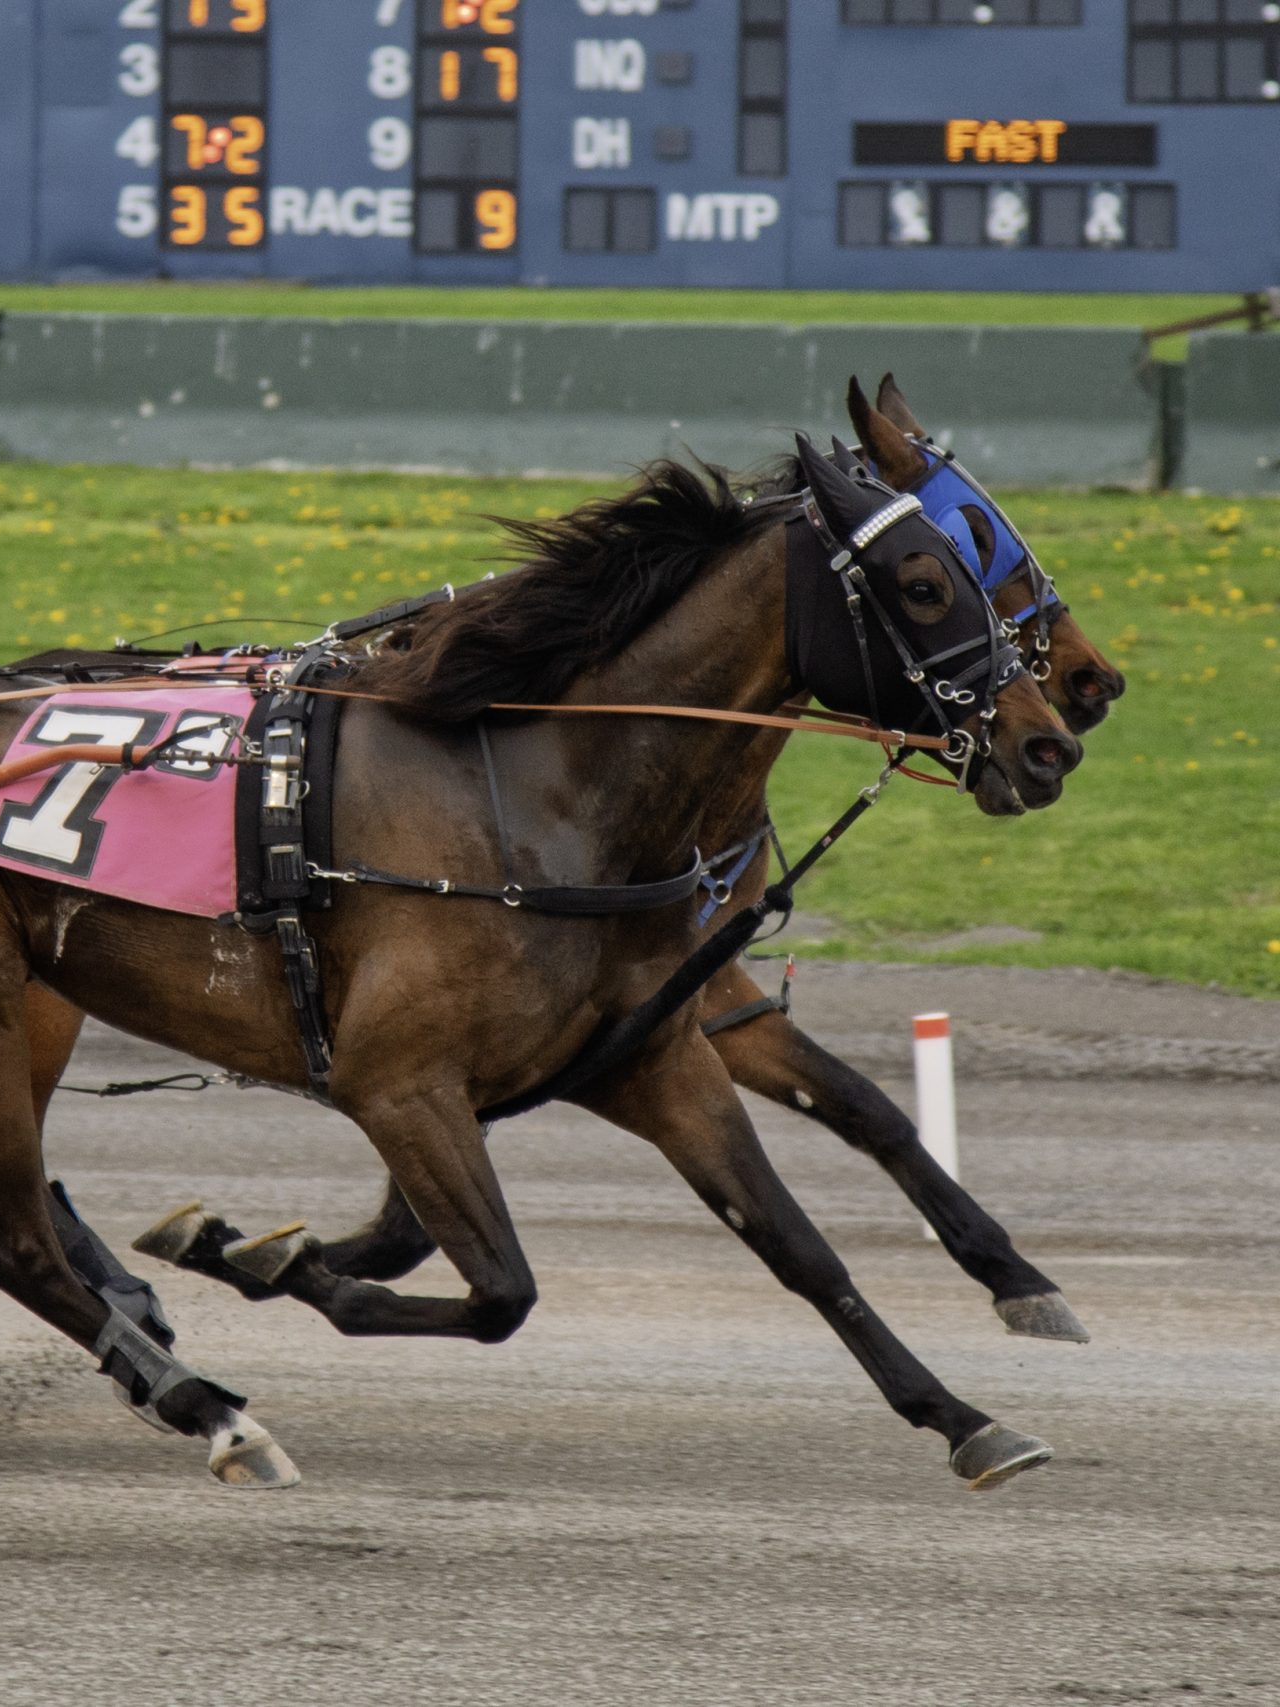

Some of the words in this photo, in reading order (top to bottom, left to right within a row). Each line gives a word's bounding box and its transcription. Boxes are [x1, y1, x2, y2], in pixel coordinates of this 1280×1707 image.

[118, 43, 159, 97] 3
[367, 46, 411, 99] 8
[574, 38, 646, 91] INQ
[116, 116, 158, 167] 4
[367, 117, 411, 170] 9
[572, 117, 630, 169] DH
[944, 119, 1067, 164] FAST
[116, 185, 158, 237] 5
[269, 186, 414, 237] RACE
[475, 189, 517, 249] 9
[665, 193, 780, 240] MTP
